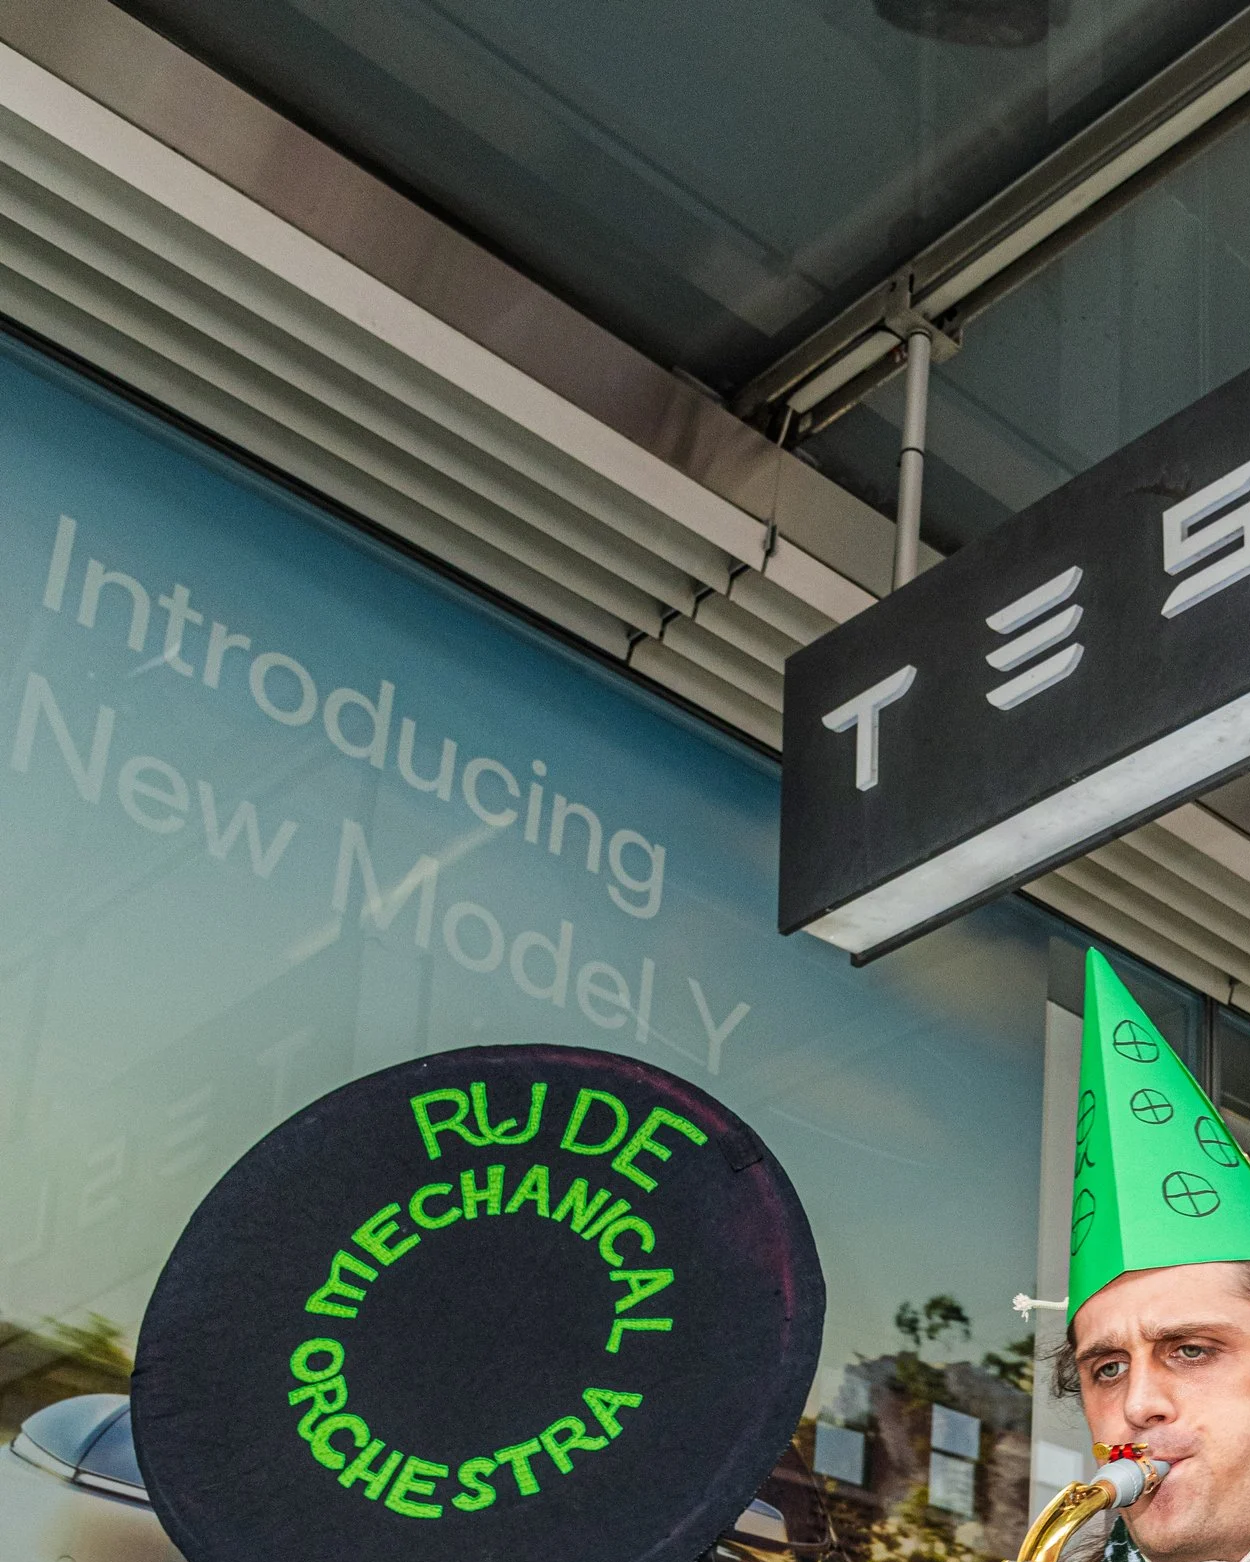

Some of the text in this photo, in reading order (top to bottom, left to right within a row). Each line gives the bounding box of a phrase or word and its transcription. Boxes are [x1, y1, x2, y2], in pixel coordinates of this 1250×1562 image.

[43, 513, 666, 920] Introducing
[9, 671, 752, 1096] New Model Y
[410, 1082, 708, 1193] RUDE
[304, 1164, 675, 1355] MECHANICAL
[288, 1337, 643, 1519] ORCHESTRA
